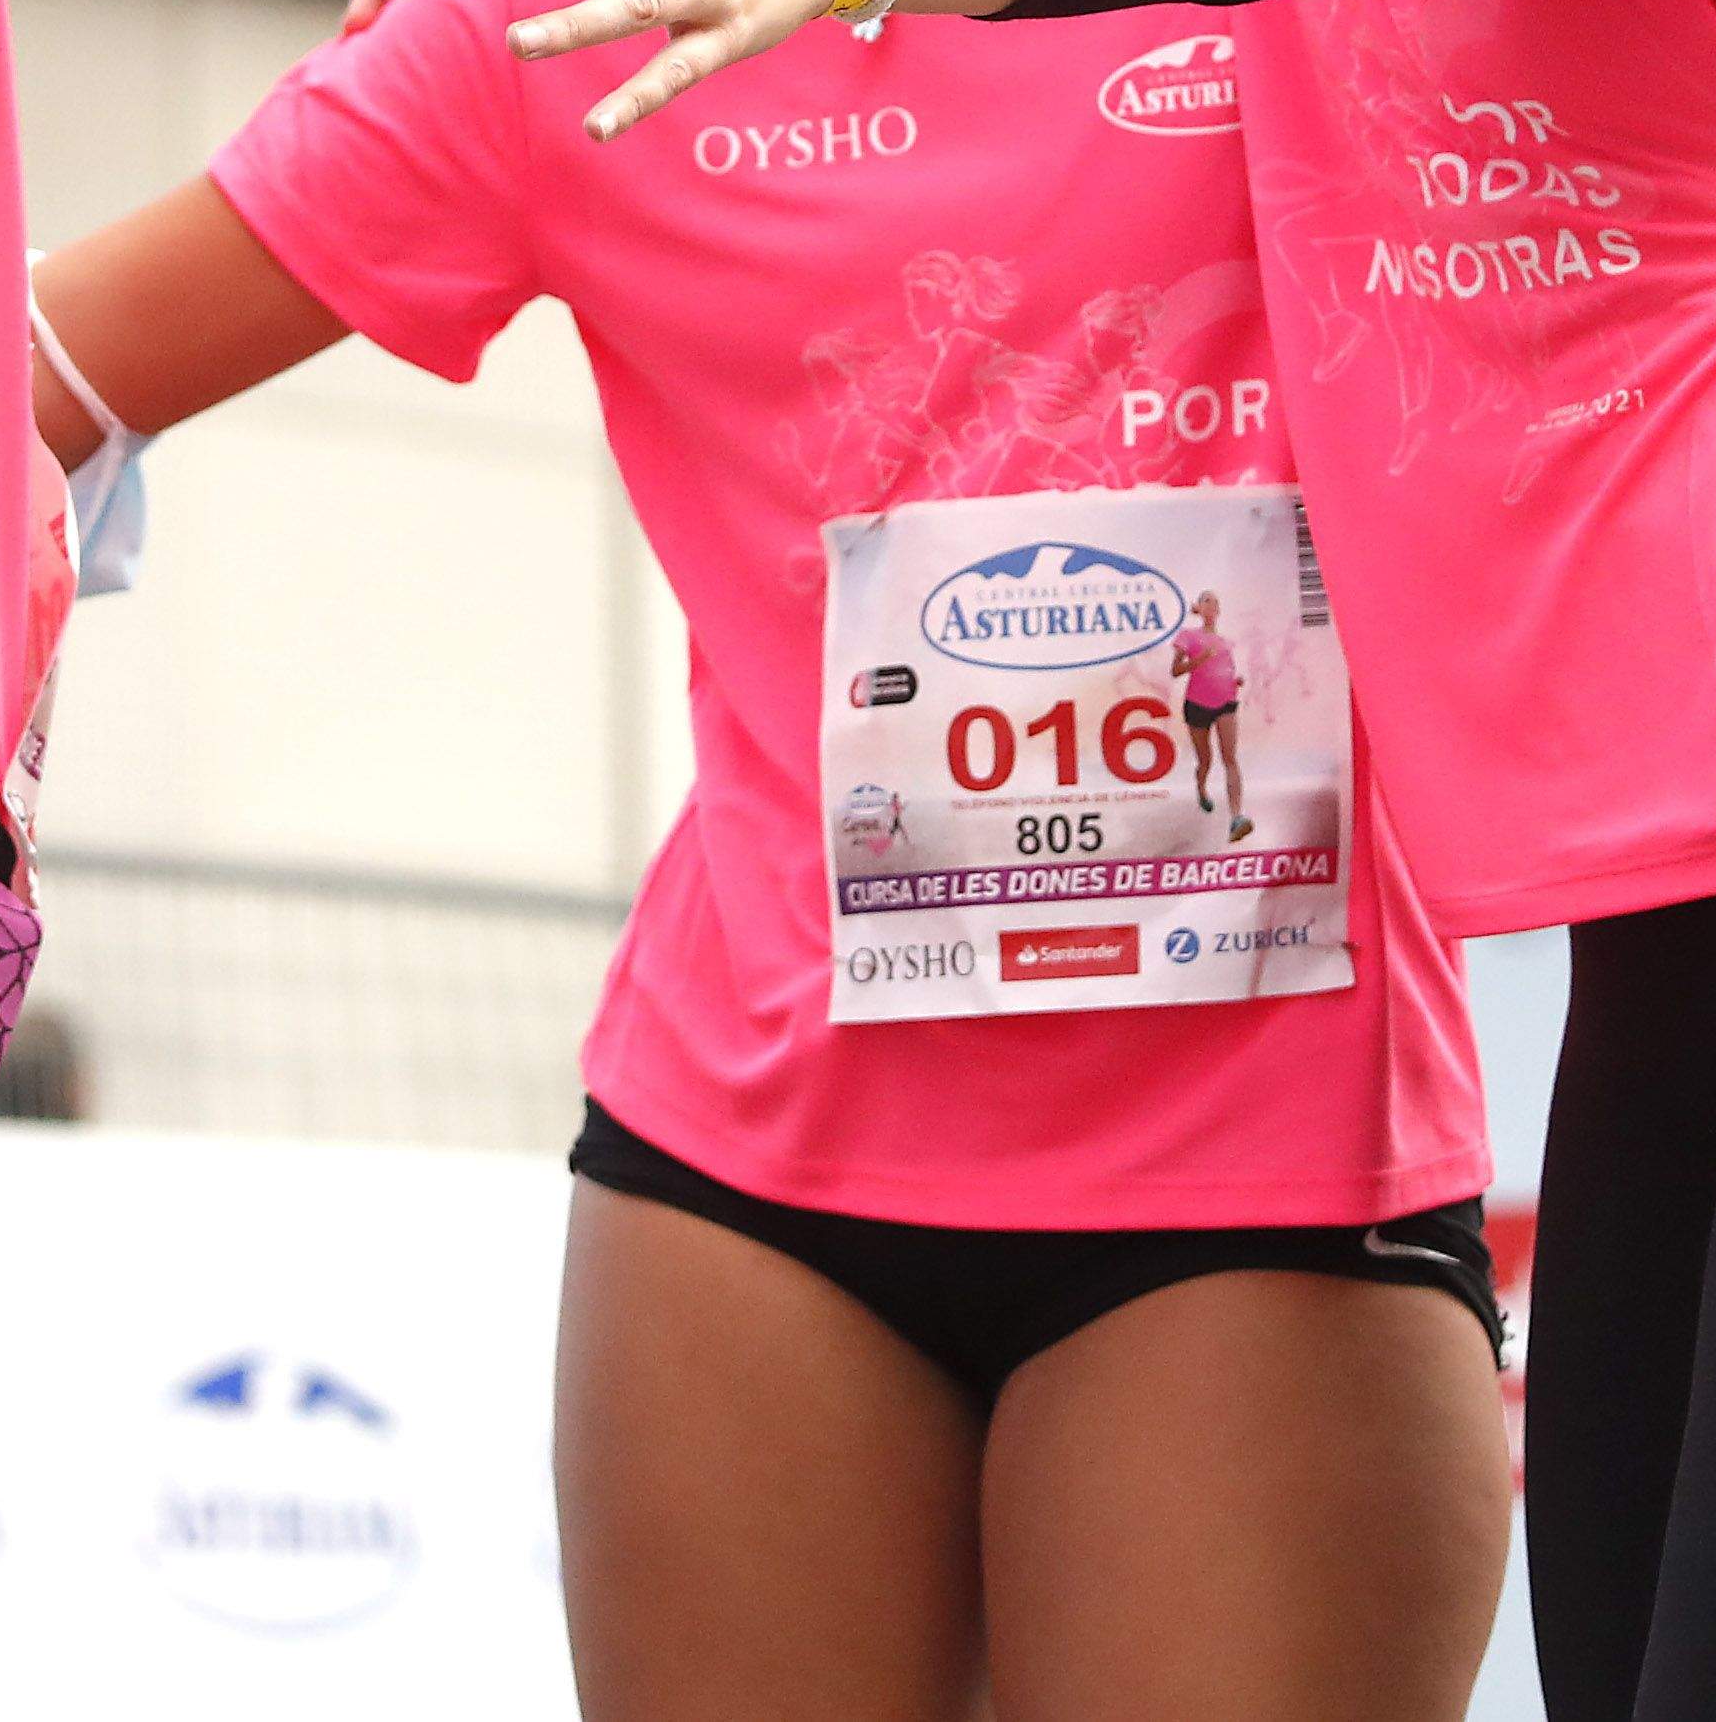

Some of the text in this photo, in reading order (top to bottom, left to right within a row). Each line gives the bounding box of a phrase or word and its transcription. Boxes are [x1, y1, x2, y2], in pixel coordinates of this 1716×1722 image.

[693, 105, 918, 175] OYSHO
[1120, 378, 1270, 448] POR
[940, 594, 1164, 642] ASTURIANA
[946, 696, 1177, 793] 016
[1016, 812, 1103, 855] 805
[846, 853, 1330, 908] CURSA DE LES DONES DE BARCELONA
[849, 940, 976, 983] OYSHO
[1040, 942, 1123, 962] Santander
[1213, 926, 1310, 953] ZURICH
